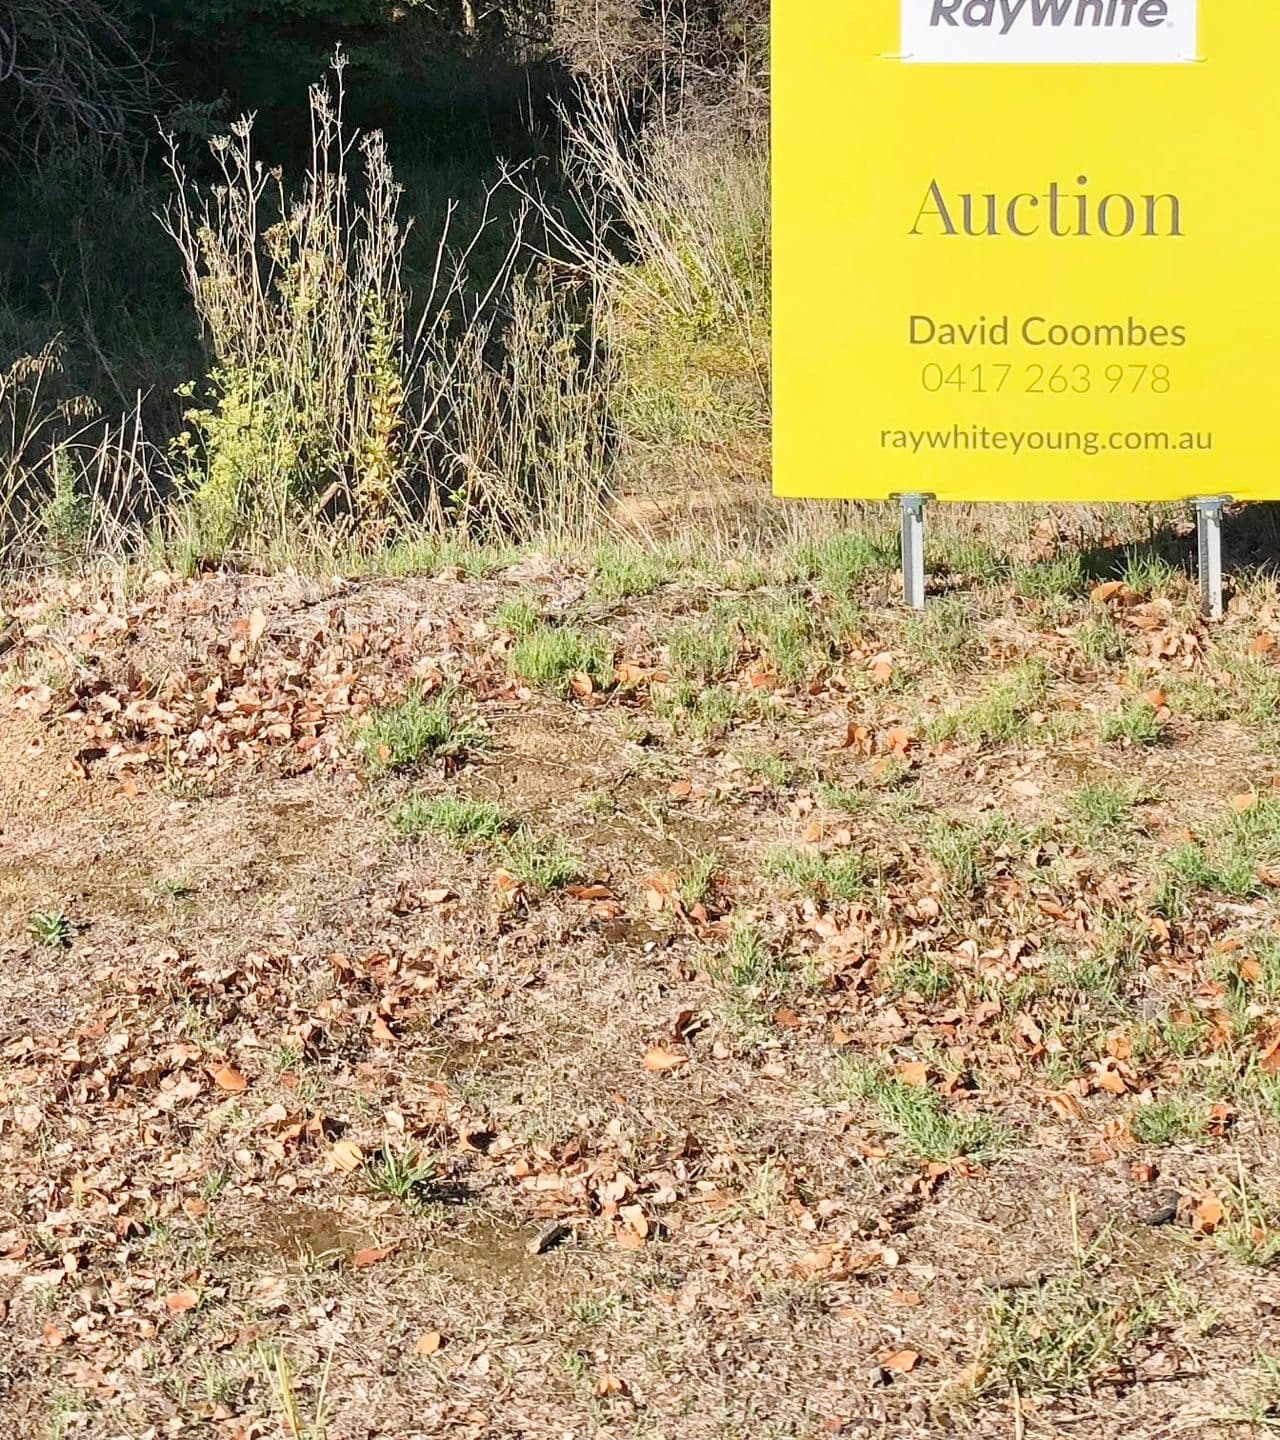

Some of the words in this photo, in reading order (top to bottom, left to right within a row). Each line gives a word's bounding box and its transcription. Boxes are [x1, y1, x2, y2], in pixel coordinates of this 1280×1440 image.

[907, 174, 1185, 238] Auction
[909, 315, 1008, 346] David
[1021, 316, 1186, 347] Coombes
[921, 362, 1012, 393] 0417
[1024, 363, 1091, 394] 263
[1104, 363, 1171, 394] 978
[880, 423, 1212, 456] raywhiteyoung.com.au
